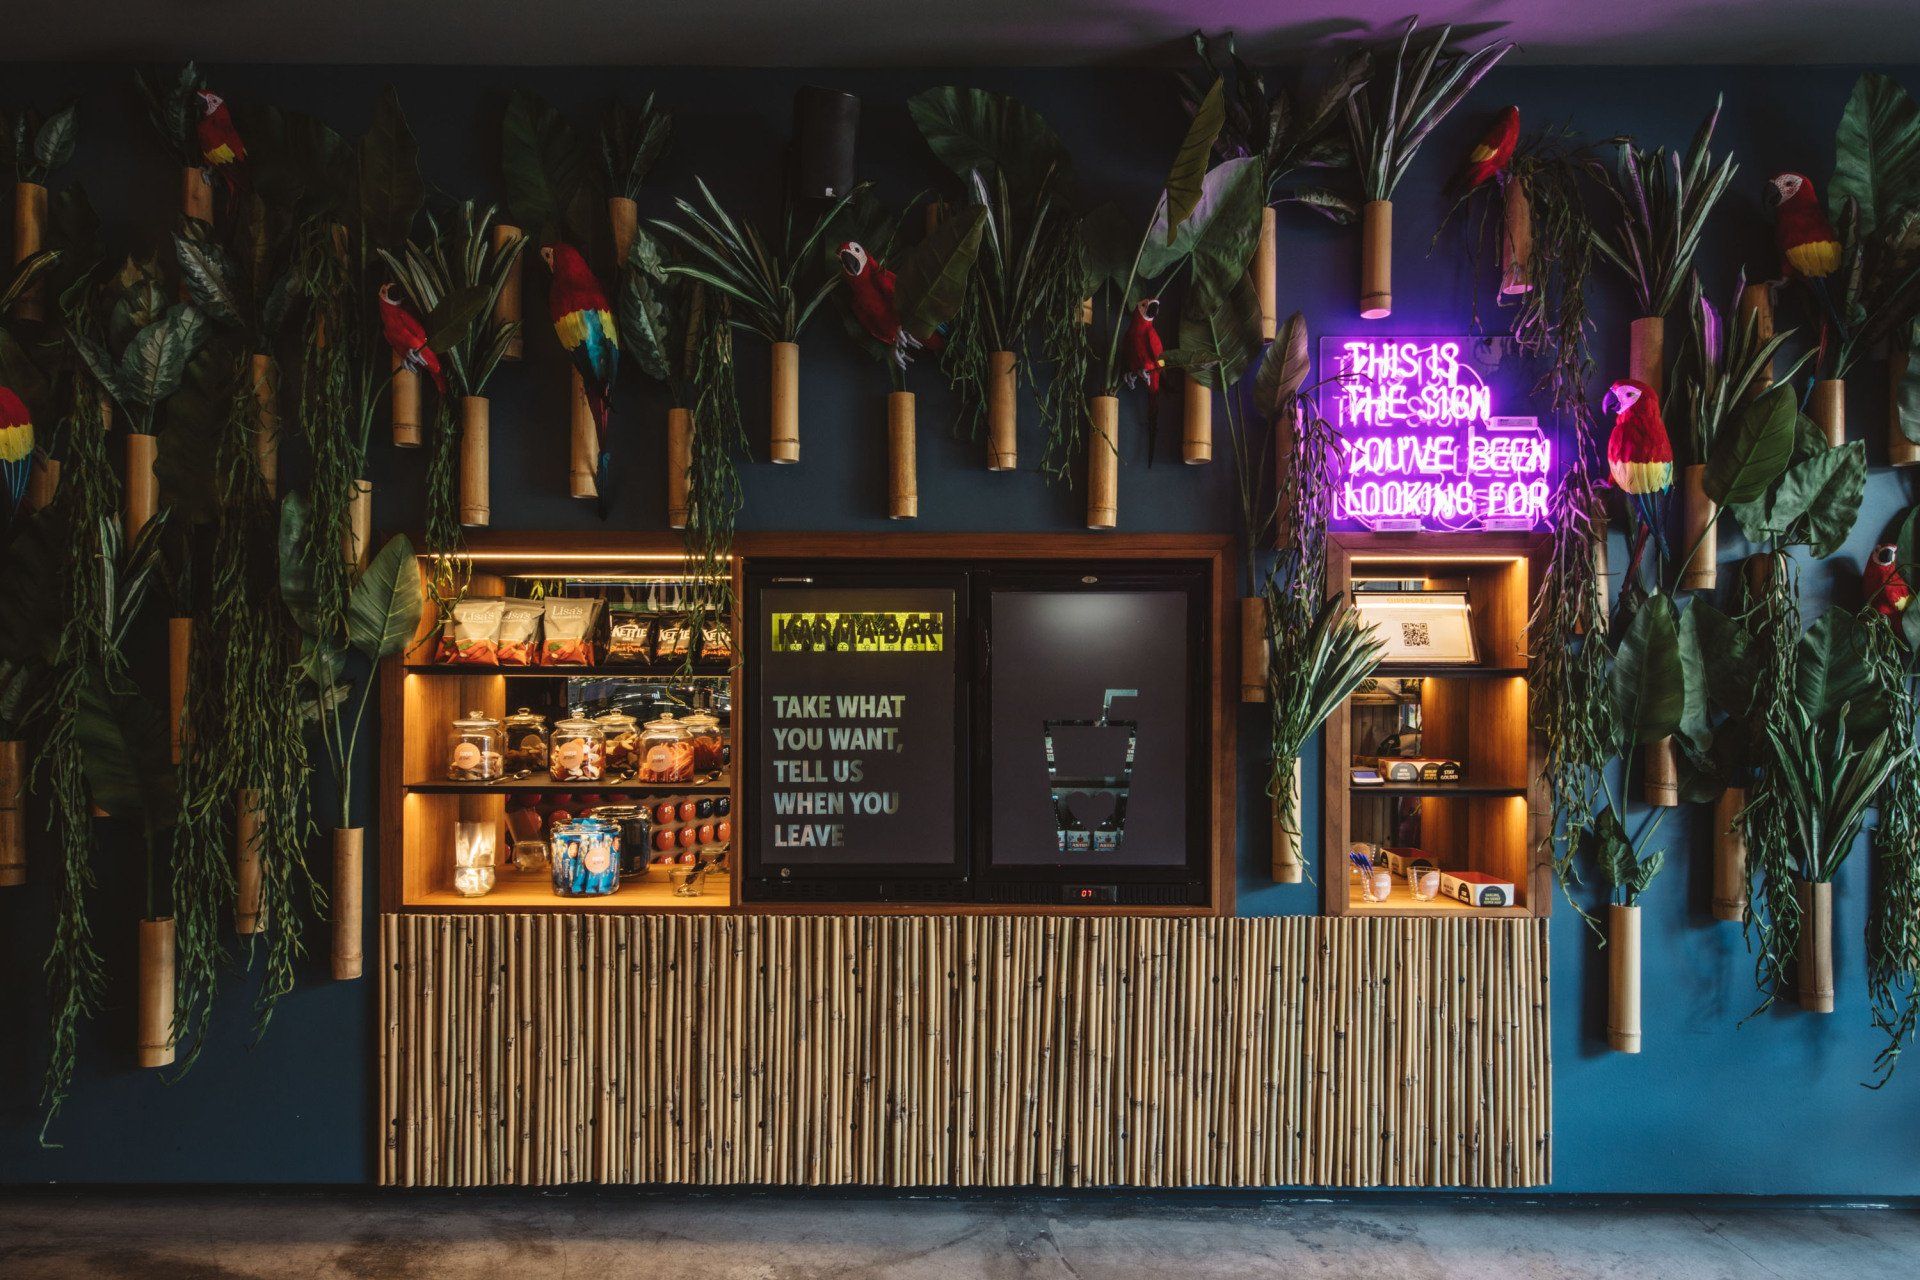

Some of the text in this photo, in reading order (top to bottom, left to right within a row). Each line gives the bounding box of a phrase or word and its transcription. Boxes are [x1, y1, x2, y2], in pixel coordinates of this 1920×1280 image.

[1343, 342, 1460, 380] THIS IS
[1341, 384, 1491, 421] THE SIGN
[1467, 437, 1551, 474] BEEN
[1343, 480, 1550, 517] LOOKING FOR
[461, 611, 495, 622] Lisa's
[552, 605, 583, 616] Lisa's
[611, 624, 648, 638] KETTLE
[773, 695, 905, 718] TAKE WHAT
[773, 728, 903, 753] YOU WANT,
[773, 760, 864, 783] TELL US
[774, 792, 899, 815] WHEN YOU
[774, 824, 844, 847] LEAVE
